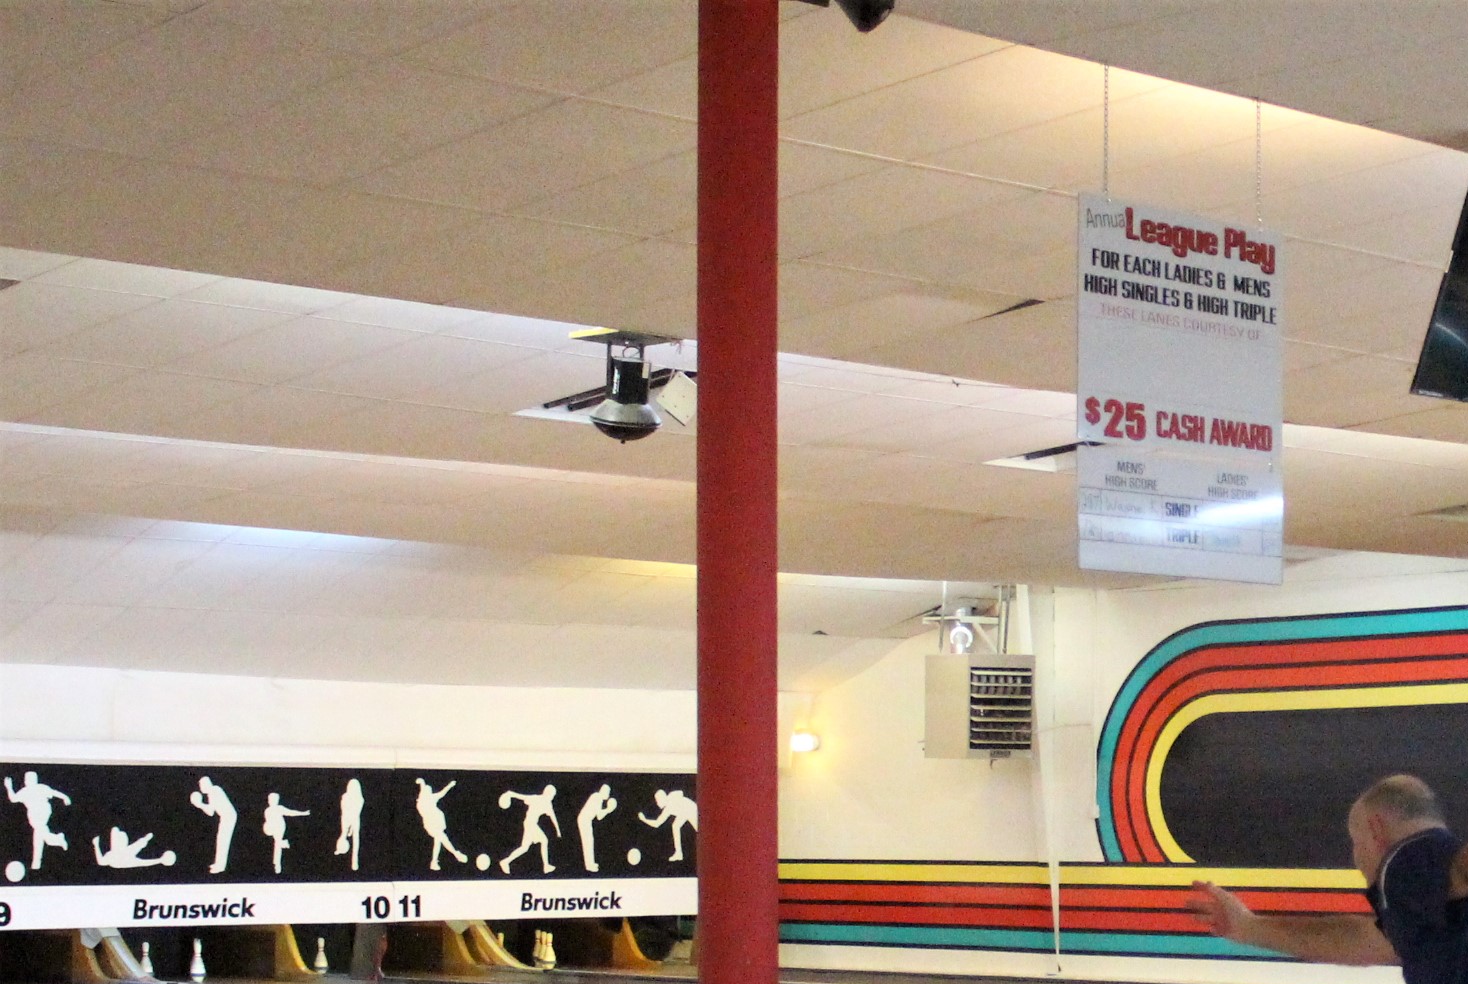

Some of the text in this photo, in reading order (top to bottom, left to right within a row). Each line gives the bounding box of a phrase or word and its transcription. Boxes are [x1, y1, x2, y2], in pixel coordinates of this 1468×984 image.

[1125, 207, 1275, 274] League Play
[1092, 248, 1119, 270] FOR
[1124, 254, 1161, 278] EACH
[1165, 262, 1213, 288] LADIES
[1234, 275, 1270, 298] MENS
[1084, 274, 1117, 296] HIGH
[1122, 280, 1179, 307] SINGLES
[1198, 294, 1228, 316] HIGH
[1233, 301, 1277, 325] TRIPLE
[1141, 312, 1180, 328] LANES
[1183, 318, 1244, 338] COURTESY
[1156, 411, 1273, 452] CASH AWARD
[1105, 475, 1158, 491] HIGH SCORE
[133, 898, 255, 920] Brunswick
[362, 896, 390, 919] 10
[398, 895, 421, 918] 11
[520, 891, 622, 912] Brunswick
[0, 902, 11, 927] 9
